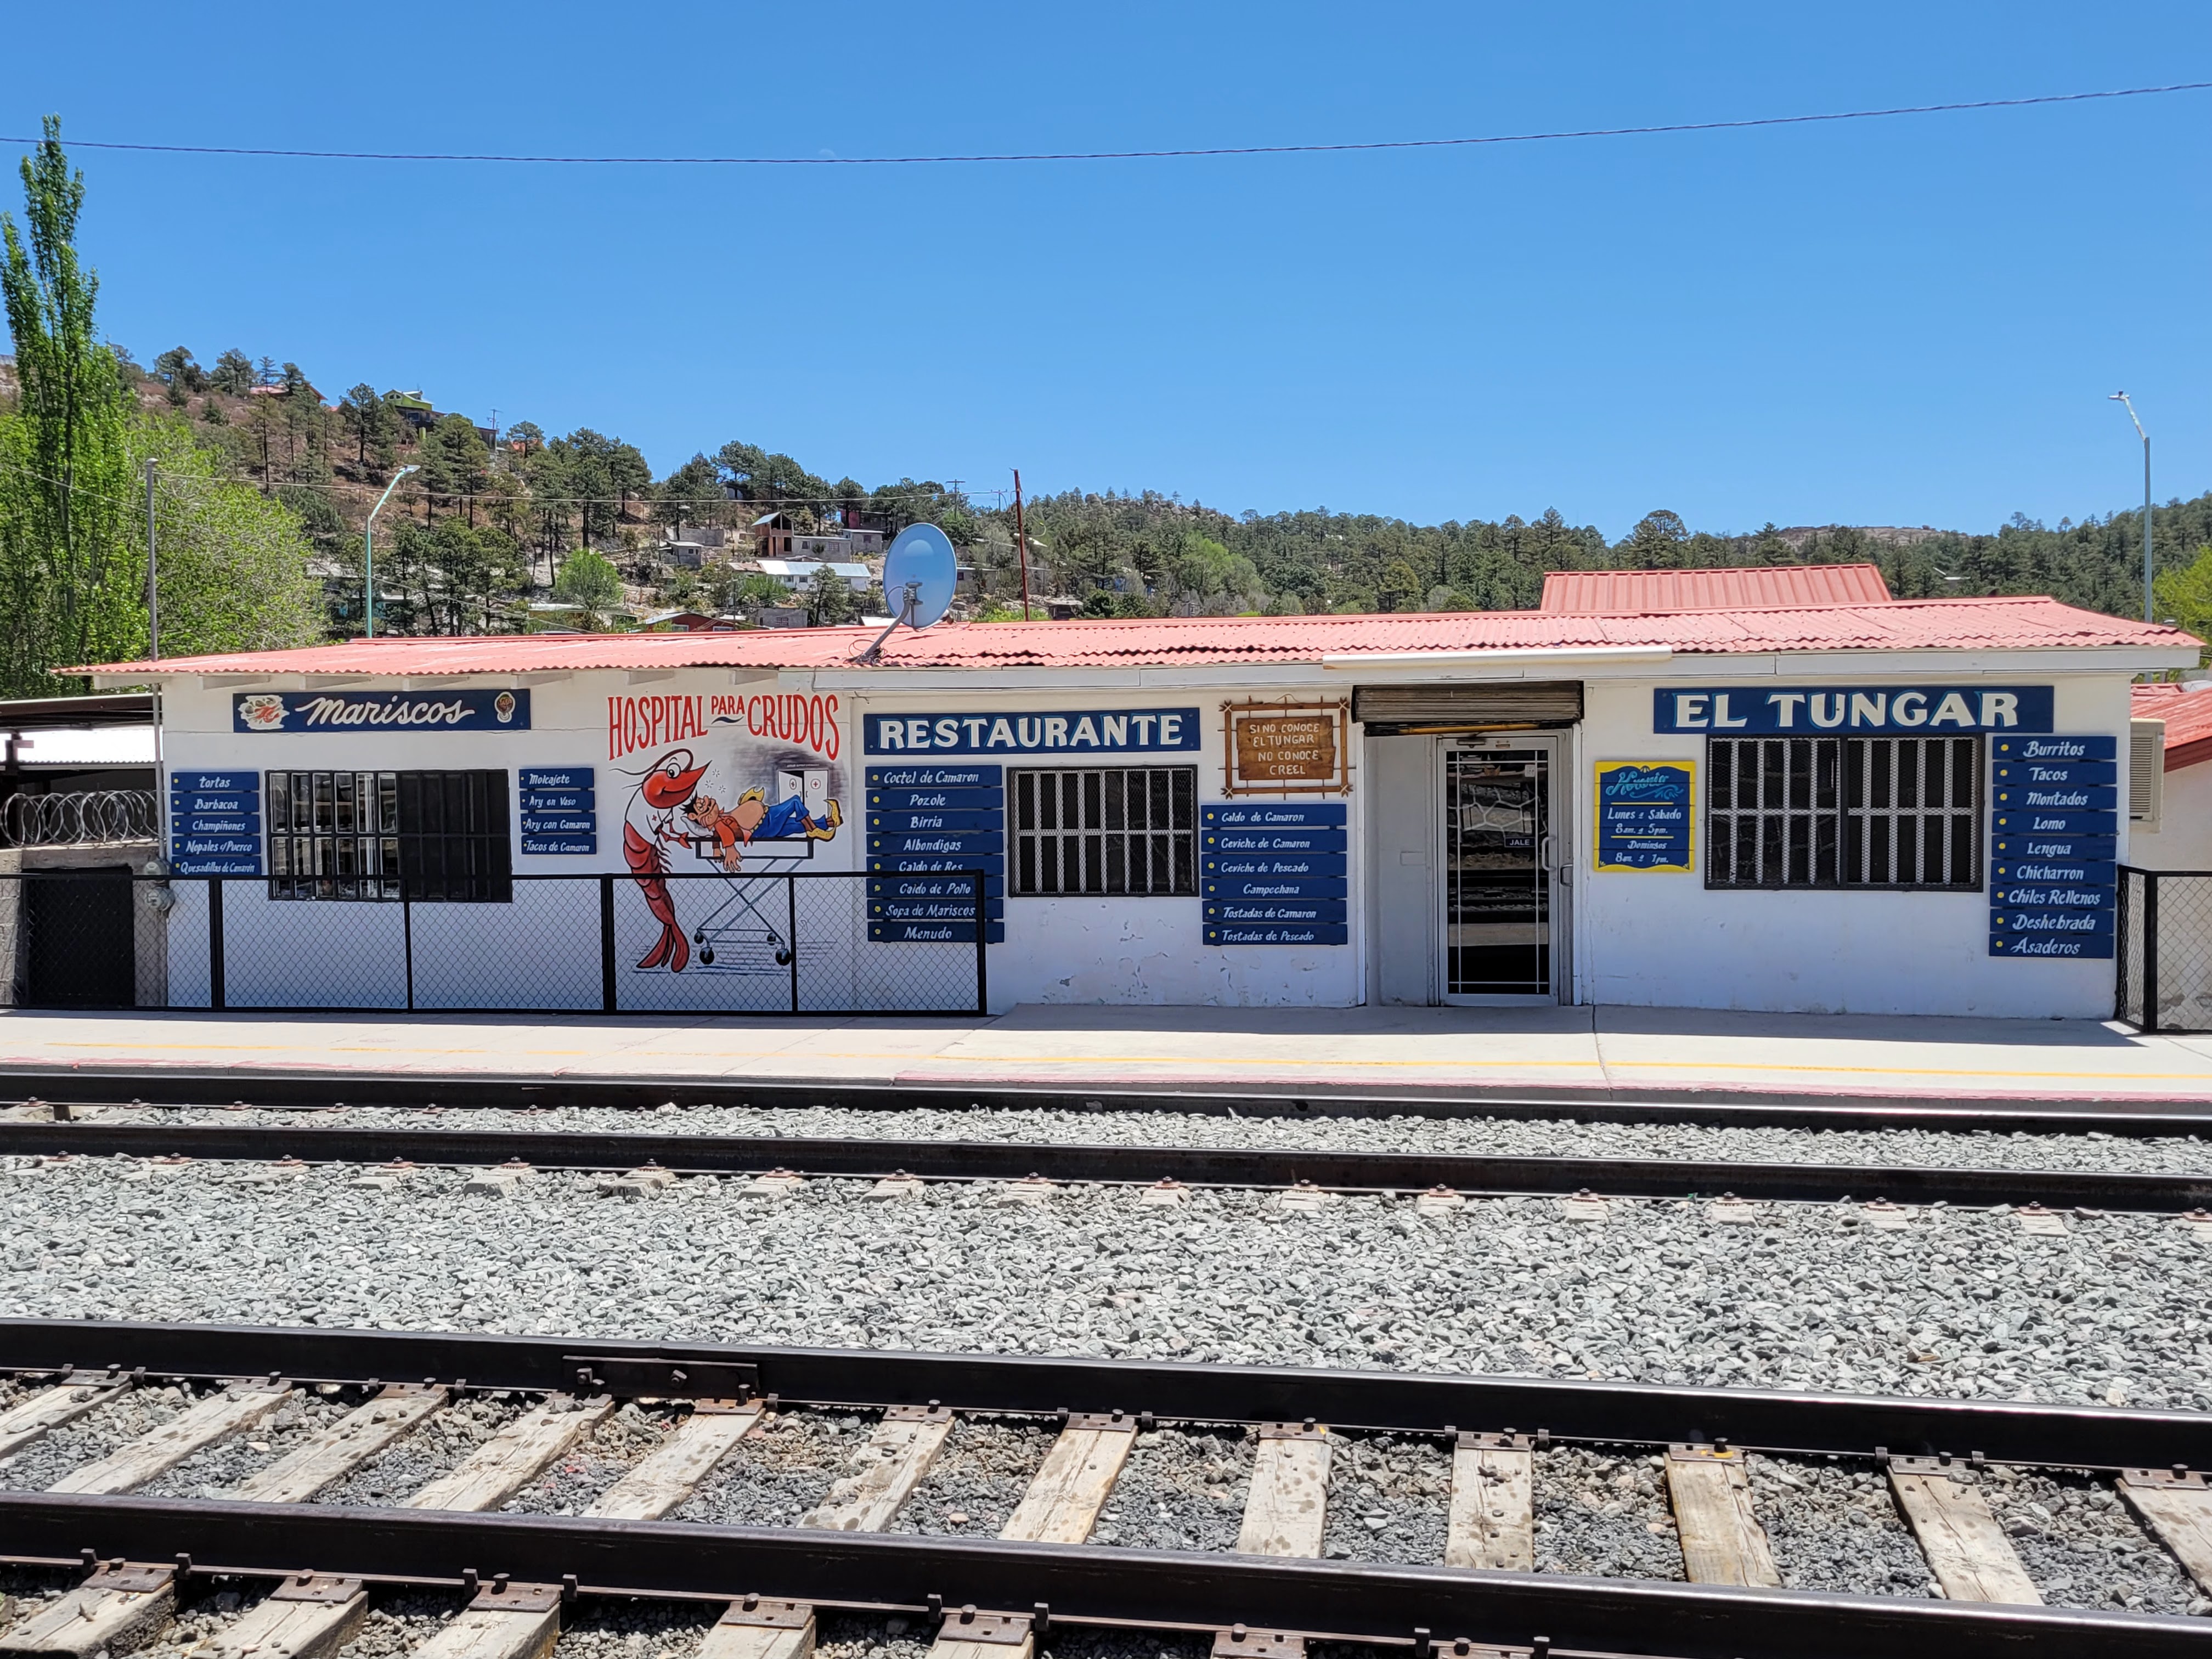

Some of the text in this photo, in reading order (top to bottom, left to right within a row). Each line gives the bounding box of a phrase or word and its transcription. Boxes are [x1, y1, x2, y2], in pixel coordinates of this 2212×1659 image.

[295, 695, 475, 726] Mariscos
[1673, 692, 2019, 728] EL TUNGAR
[607, 693, 840, 761] HOSPITAL PARA CRUDOS
[878, 714, 1183, 749] RESTAURANTE
[1249, 723, 1320, 734] SI NO CONOCE
[1252, 734, 1315, 747] EL TUNGAR
[1258, 750, 1319, 762] NO CONOCE
[2023, 741, 2085, 758] Burritos
[1269, 765, 1306, 775] CREEL
[2028, 767, 2068, 781] Tacos
[529, 774, 570, 786] Molcajete
[884, 770, 979, 784] Coctel de Camaron
[194, 798, 238, 809] Barbacoa
[529, 795, 543, 808] Ary
[560, 796, 576, 806] Vaso
[909, 793, 946, 806] Pozole
[2026, 791, 2089, 806] Montados
[1221, 811, 1305, 822] Caldo de Camaron
[1607, 808, 1635, 820] Lunes
[1648, 809, 1681, 820] Sabado
[193, 819, 246, 833] Champiñones
[524, 818, 541, 832] Ary
[560, 820, 590, 829] Camaron
[910, 815, 943, 828] Birria
[2033, 816, 2066, 830] Lomo
[185, 840, 218, 854] Nopales
[526, 840, 590, 851] Tacos de Camaron
[903, 838, 962, 853] Albondigas
[1221, 837, 1310, 849] Ceviche de Camaron
[1627, 840, 1667, 850] Domingos
[2027, 842, 2072, 857] Lengua
[180, 861, 221, 874] Quesadillas
[222, 862, 228, 872] de
[899, 860, 963, 871] Caldo de Res
[1221, 862, 1309, 873] Ceviche de Pescado
[2016, 865, 2084, 880] Chicharron
[899, 882, 971, 895] Caldo de Pollo
[1243, 883, 1300, 897] Campechana
[2008, 888, 2101, 905] Chiles Rellenos
[885, 904, 976, 918] Sopa de Mariscos
[1223, 906, 1317, 918] Tostadas de Camaron
[2012, 913, 2096, 930] Deshebrada
[904, 926, 952, 939] Menudo
[1222, 930, 1314, 941] Tostadas de Pescado
[2010, 936, 2081, 955] Asaderos
